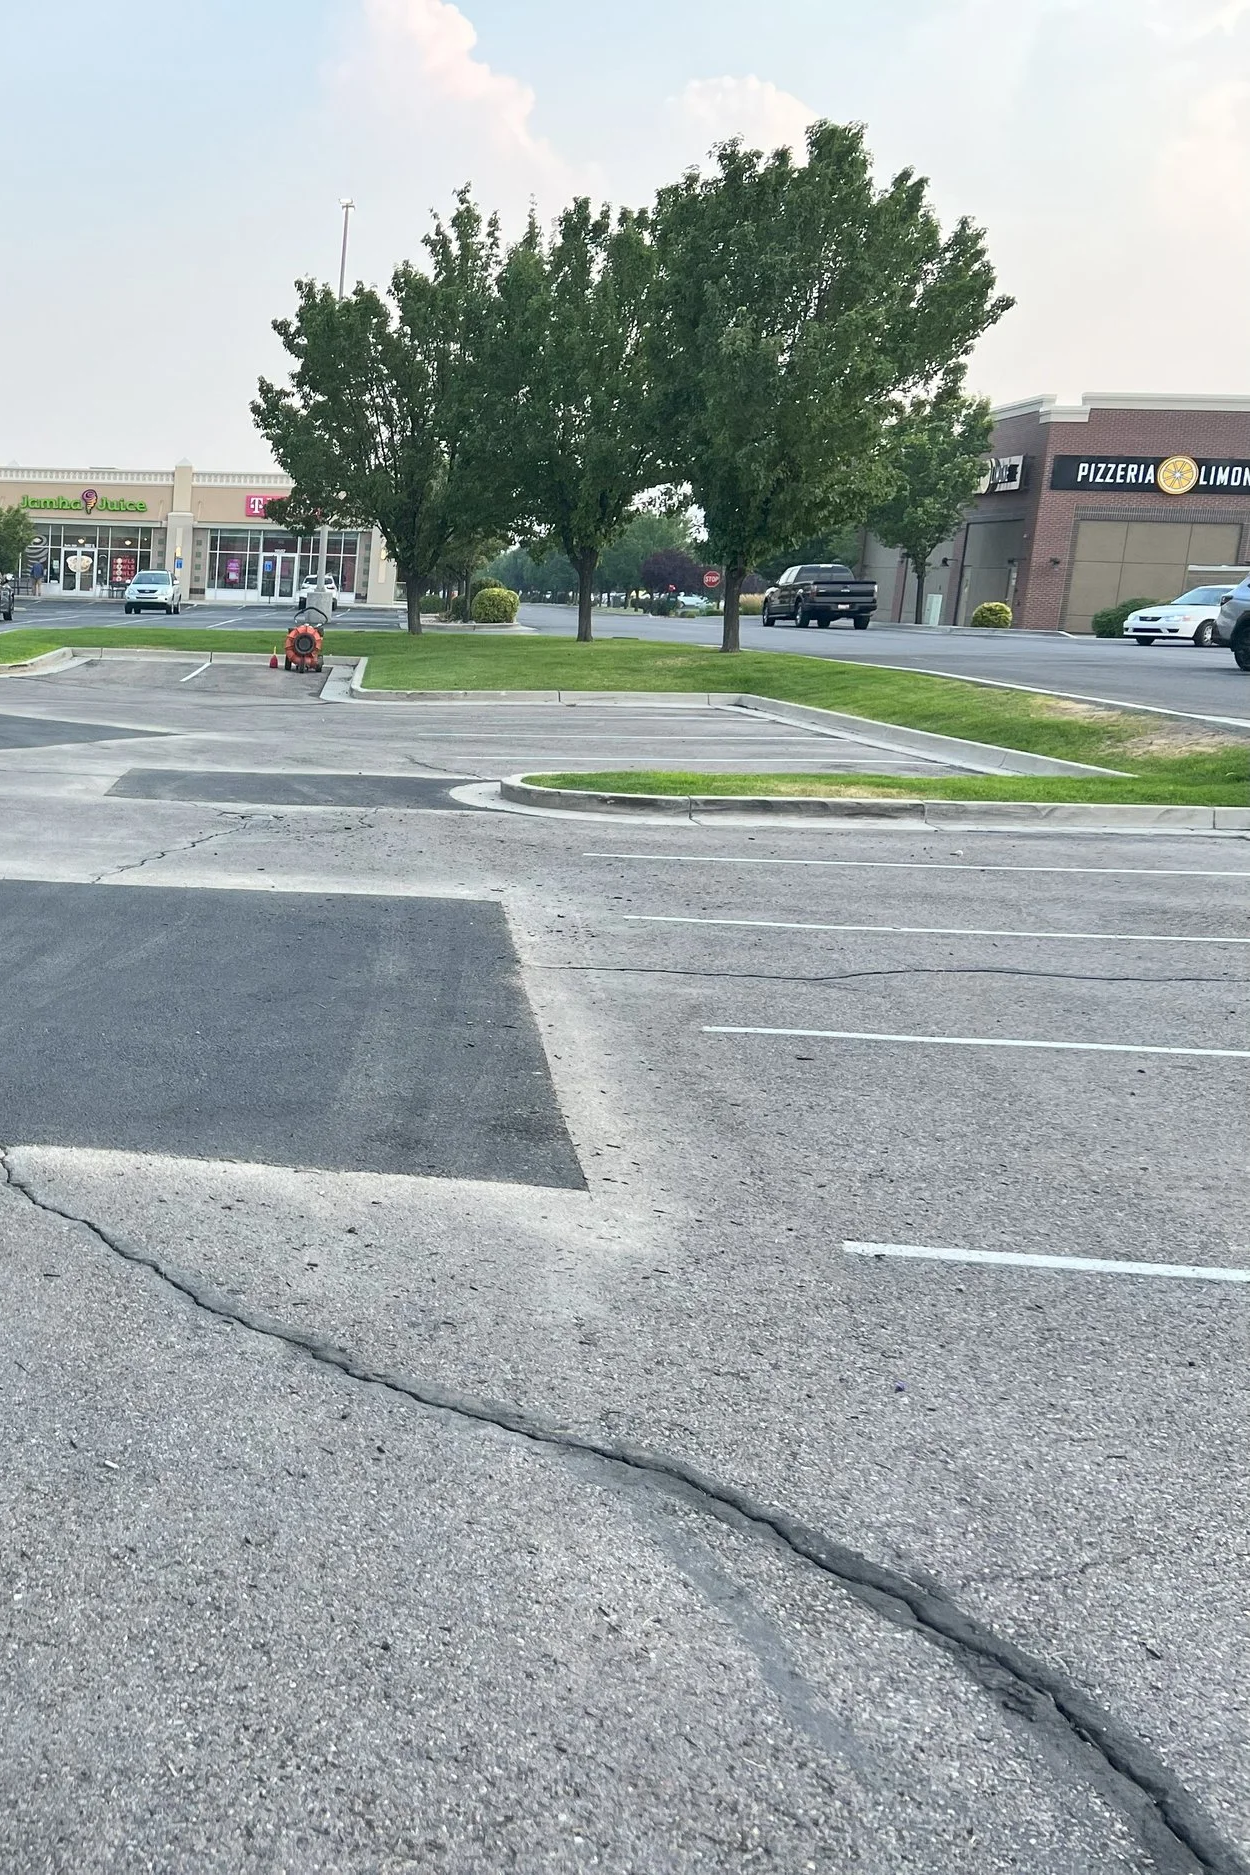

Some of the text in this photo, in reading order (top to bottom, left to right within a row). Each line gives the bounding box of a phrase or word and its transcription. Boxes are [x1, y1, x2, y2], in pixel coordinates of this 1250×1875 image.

[1077, 463, 1250, 486] PIZZERIA LIMON
[20, 495, 147, 512] Jamba Juice
